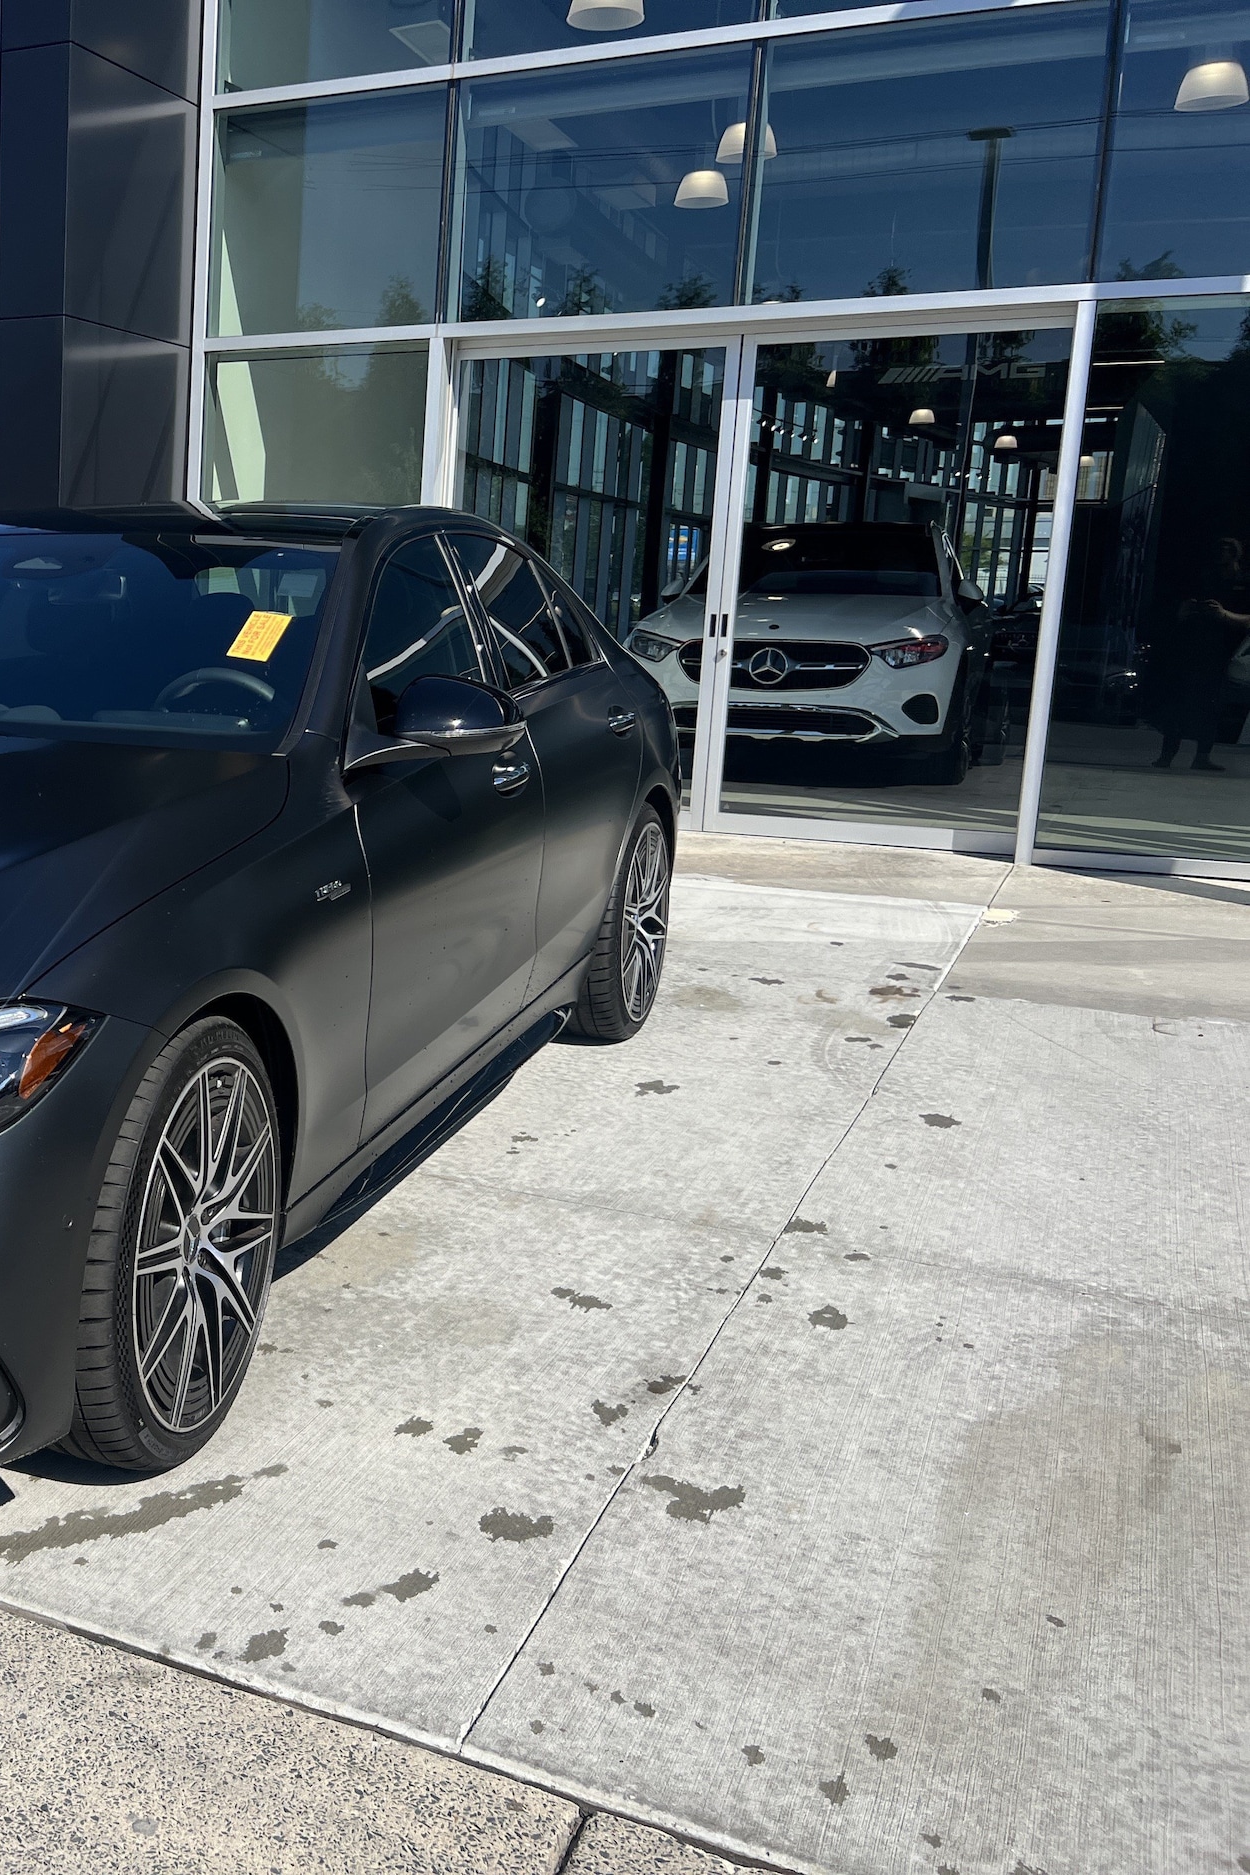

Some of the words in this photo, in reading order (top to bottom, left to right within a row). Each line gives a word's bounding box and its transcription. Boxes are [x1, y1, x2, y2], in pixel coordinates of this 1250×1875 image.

[928, 361, 1047, 383] AMG
[231, 639, 246, 653] THIS
[243, 614, 262, 639] VEHICLE
[247, 630, 261, 644] FOR
[256, 614, 272, 630] SALE
